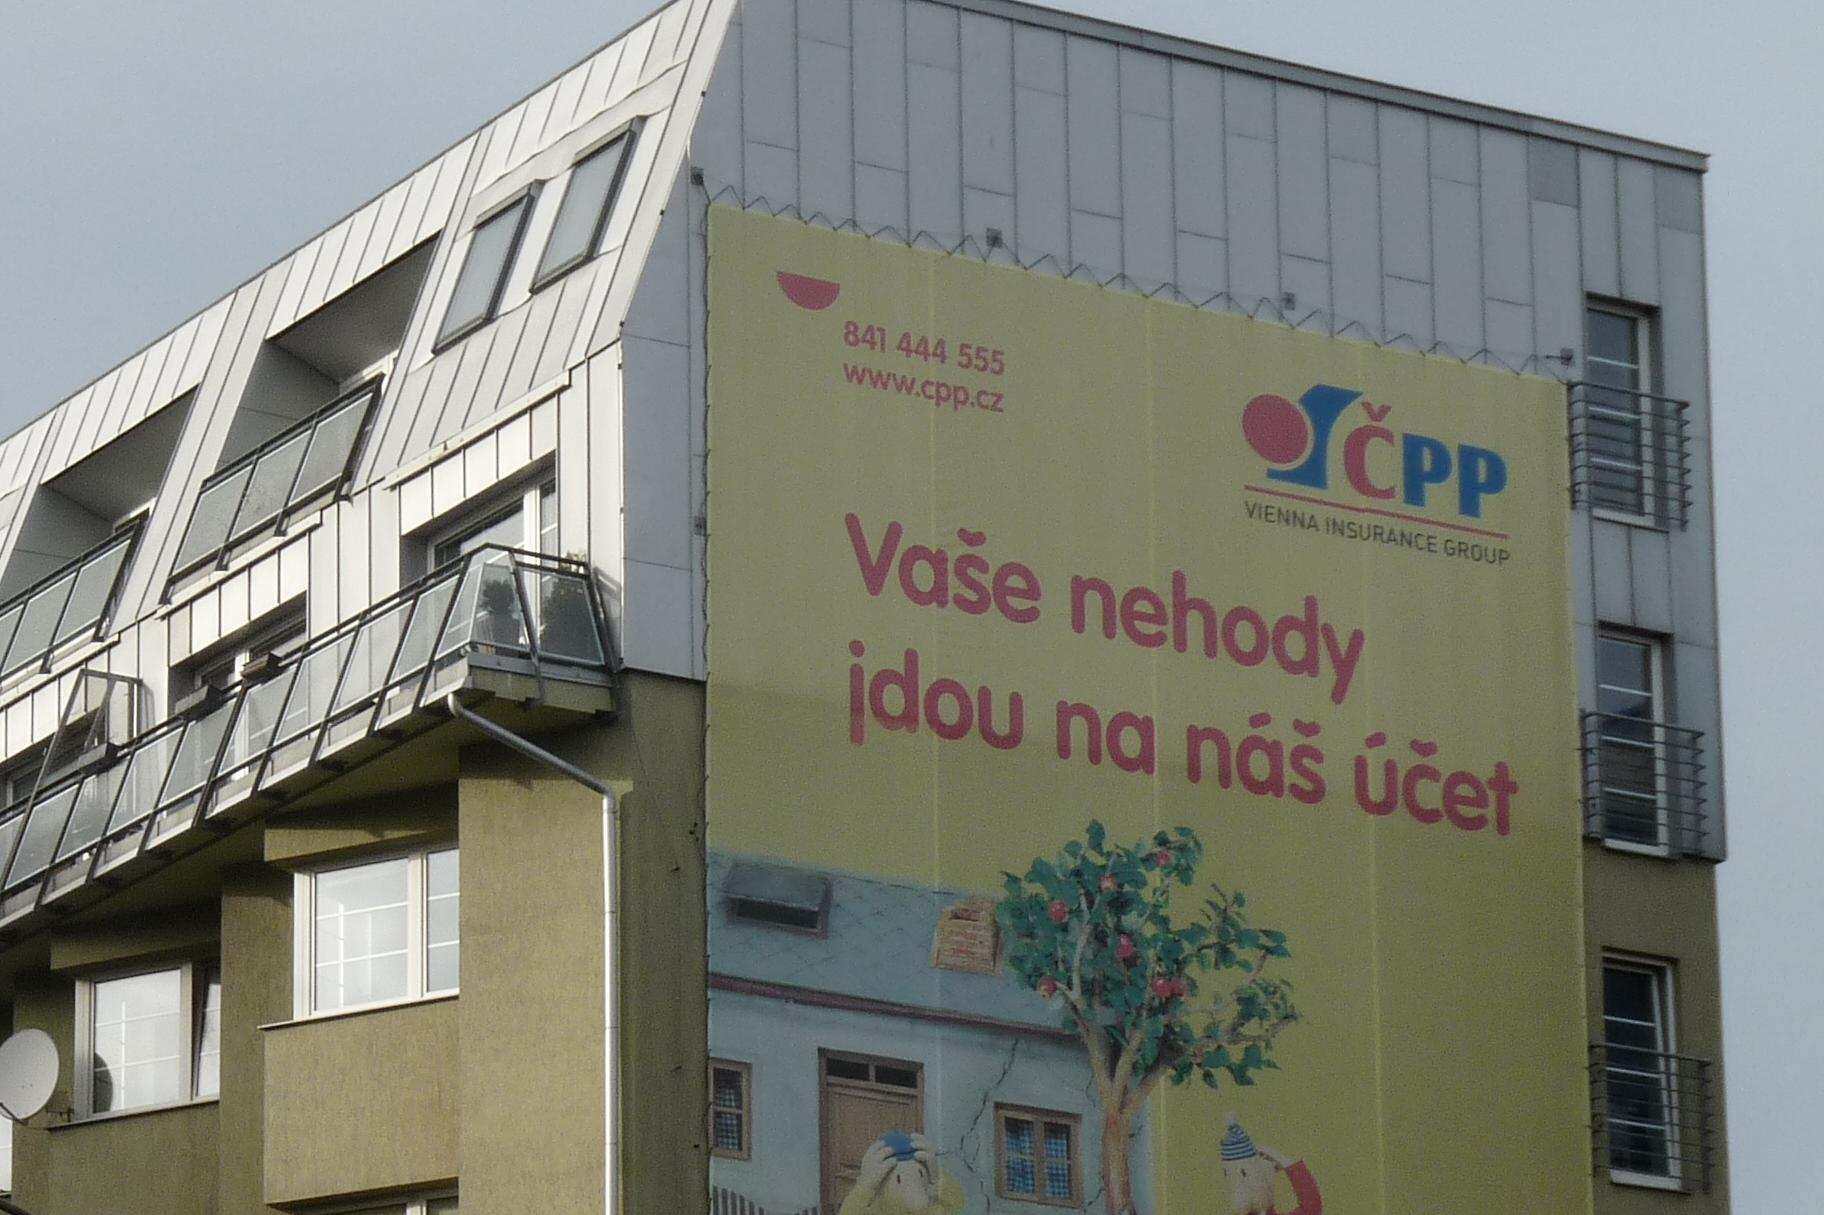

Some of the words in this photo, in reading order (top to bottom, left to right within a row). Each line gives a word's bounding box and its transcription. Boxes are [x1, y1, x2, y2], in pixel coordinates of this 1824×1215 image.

[843, 320, 886, 353] 841
[896, 331, 947, 364] 444
[958, 343, 1005, 376] 555
[843, 362, 1004, 412] www.cpp.cz
[1343, 400, 1508, 519] ČPP
[1245, 500, 1320, 532] VIENNA
[1326, 516, 1438, 553] INSURANCE
[1443, 538, 1510, 567] GROUP
[845, 512, 1042, 624] Vaše
[1070, 570, 1365, 705] nehody
[849, 639, 1024, 750] jdou
[1056, 700, 1156, 775] na
[1186, 711, 1327, 804] náš
[1354, 731, 1520, 836] účet
